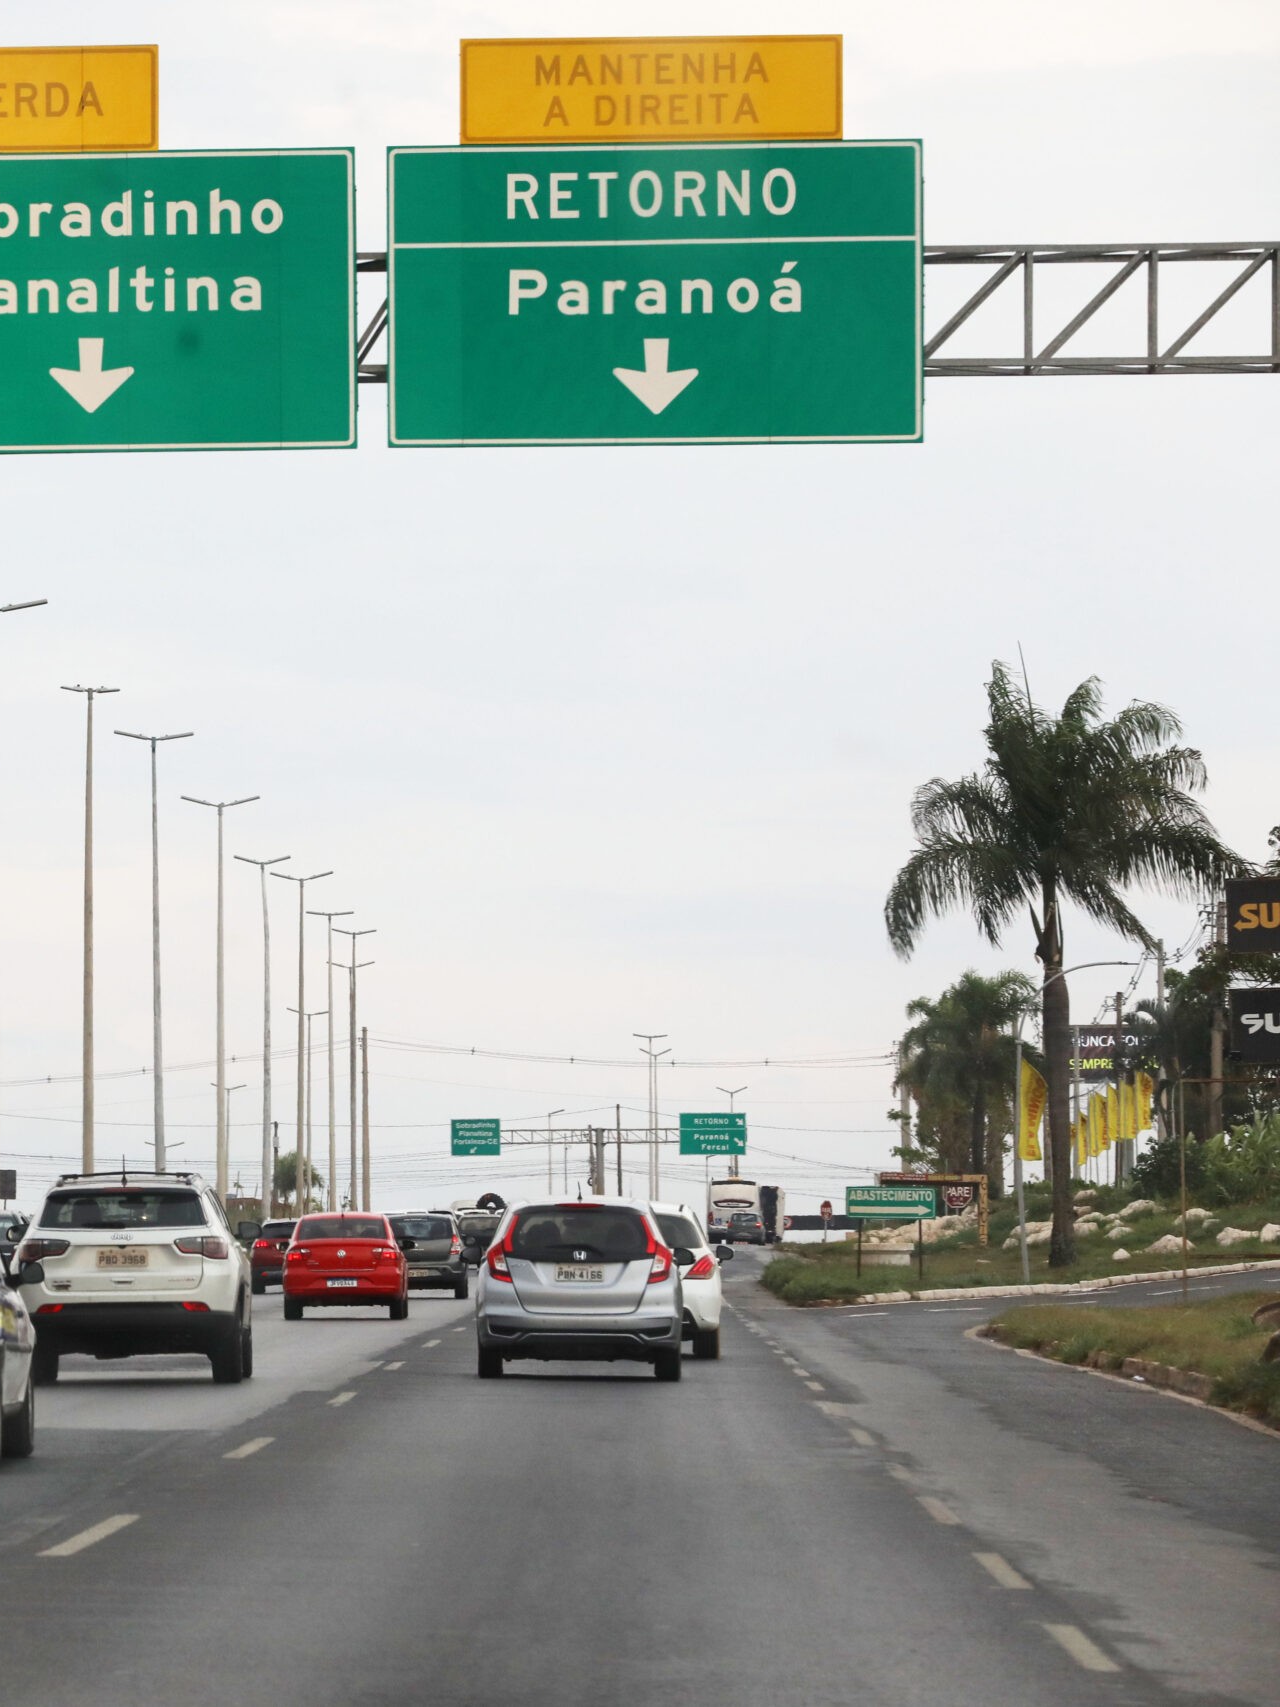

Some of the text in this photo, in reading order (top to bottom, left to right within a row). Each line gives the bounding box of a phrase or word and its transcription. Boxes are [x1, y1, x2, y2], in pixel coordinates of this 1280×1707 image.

[534, 52, 770, 87] MANTENHA
[543, 93, 760, 127] A DIREITA
[506, 168, 797, 220] RETORNO
[507, 261, 803, 316] Paranoá
[693, 1132, 729, 1141] Paranoá
[701, 1143, 729, 1151] Fercal
[849, 1189, 933, 1202] ABASTECIMENTO
